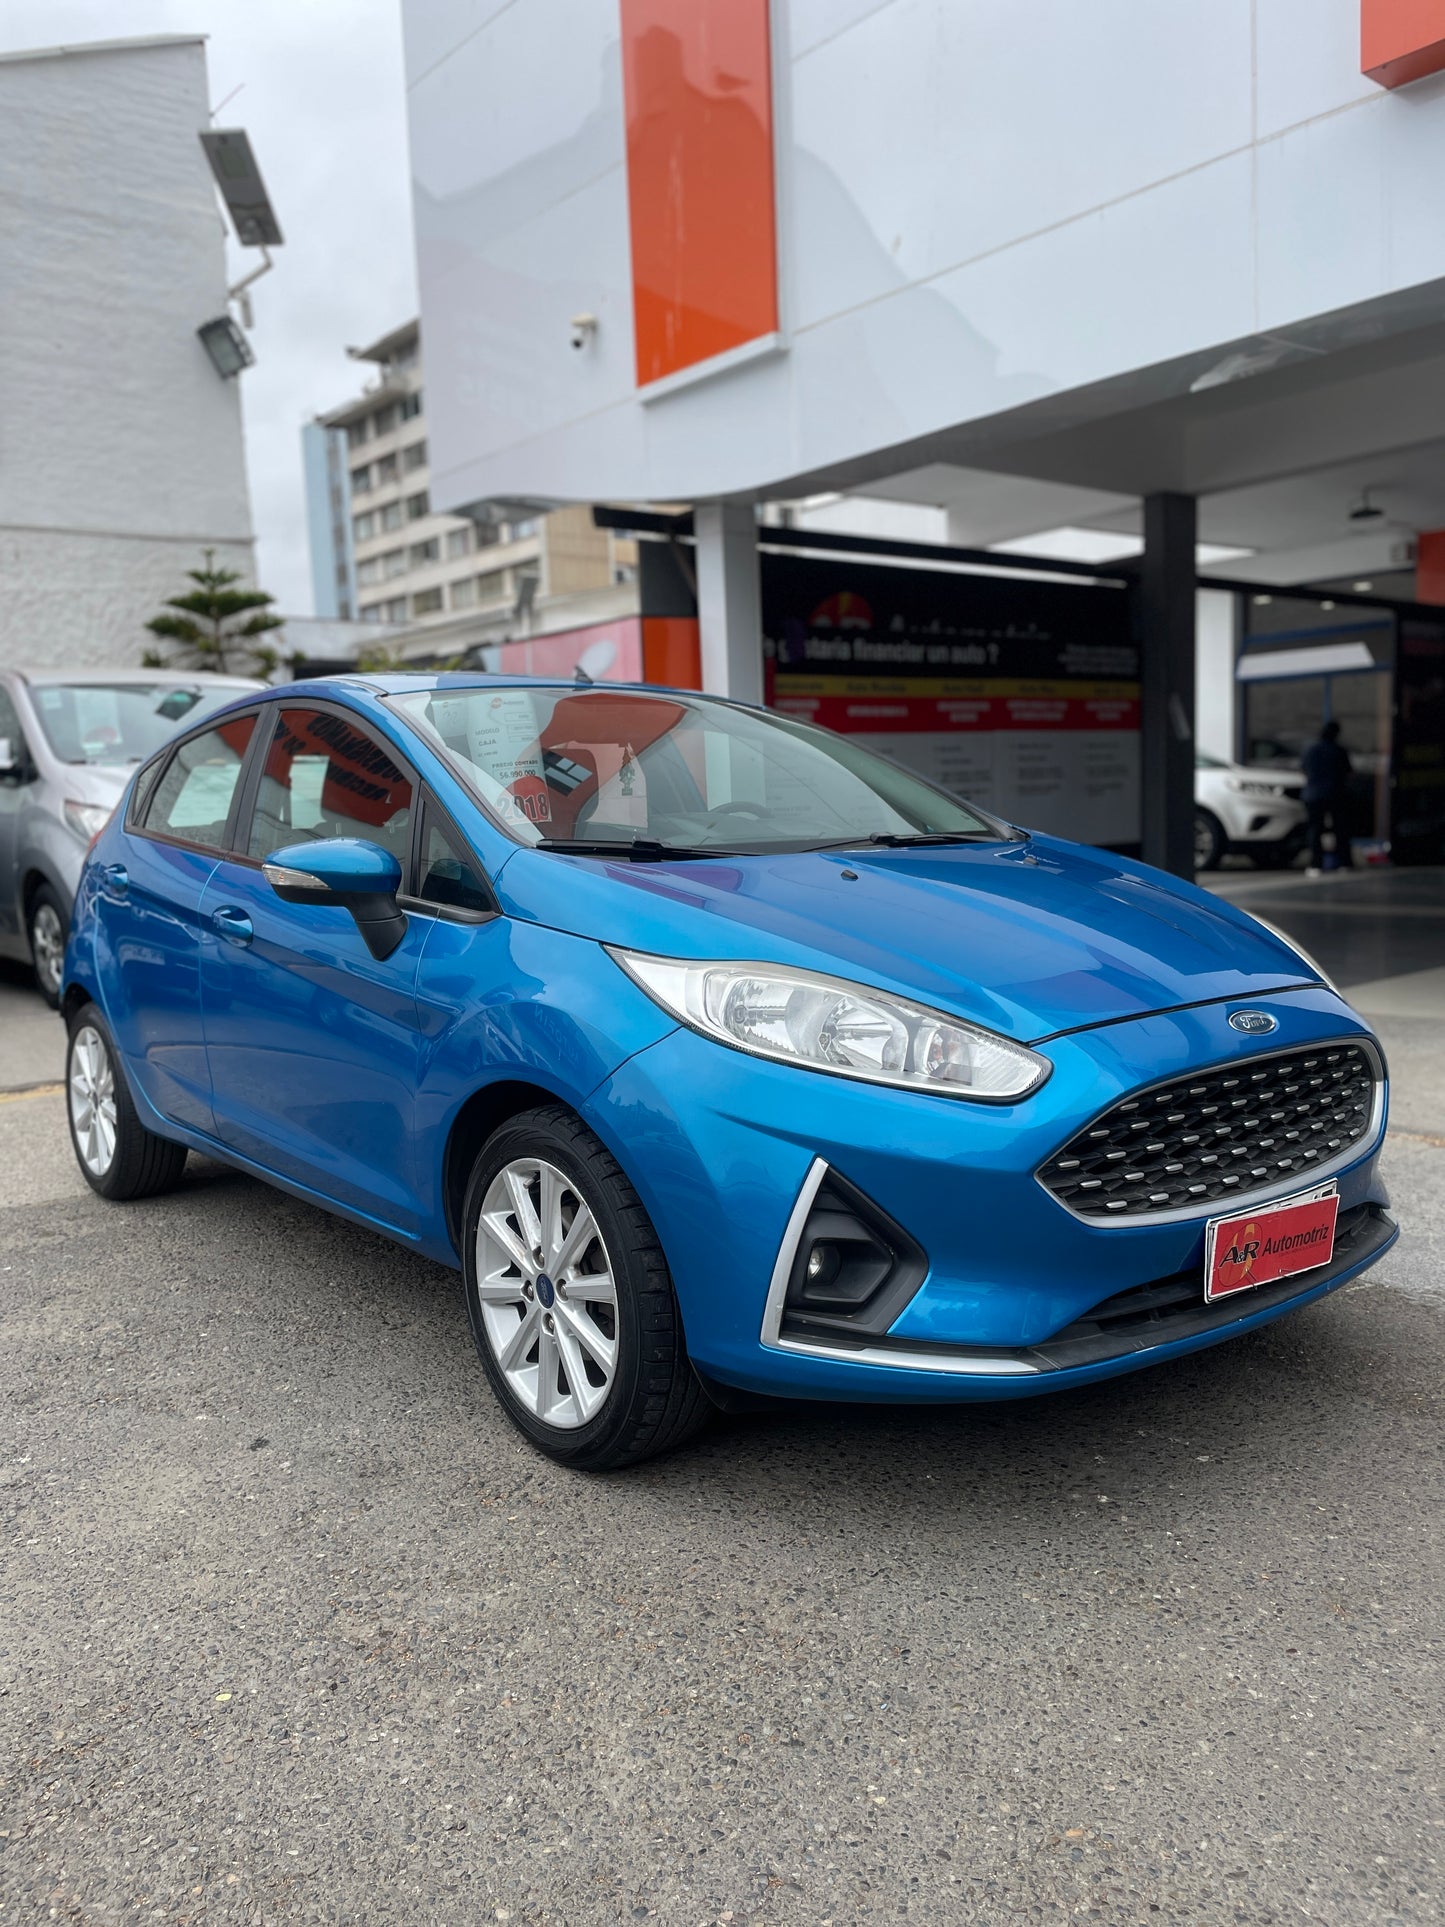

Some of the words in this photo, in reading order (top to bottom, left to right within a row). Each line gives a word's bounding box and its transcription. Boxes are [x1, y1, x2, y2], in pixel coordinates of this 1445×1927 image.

[495, 793, 549, 820] 2018
[1239, 1013, 1267, 1029] Ford
[1219, 1241, 1260, 1267] A&R
[1262, 1224, 1330, 1256] Automotriz
